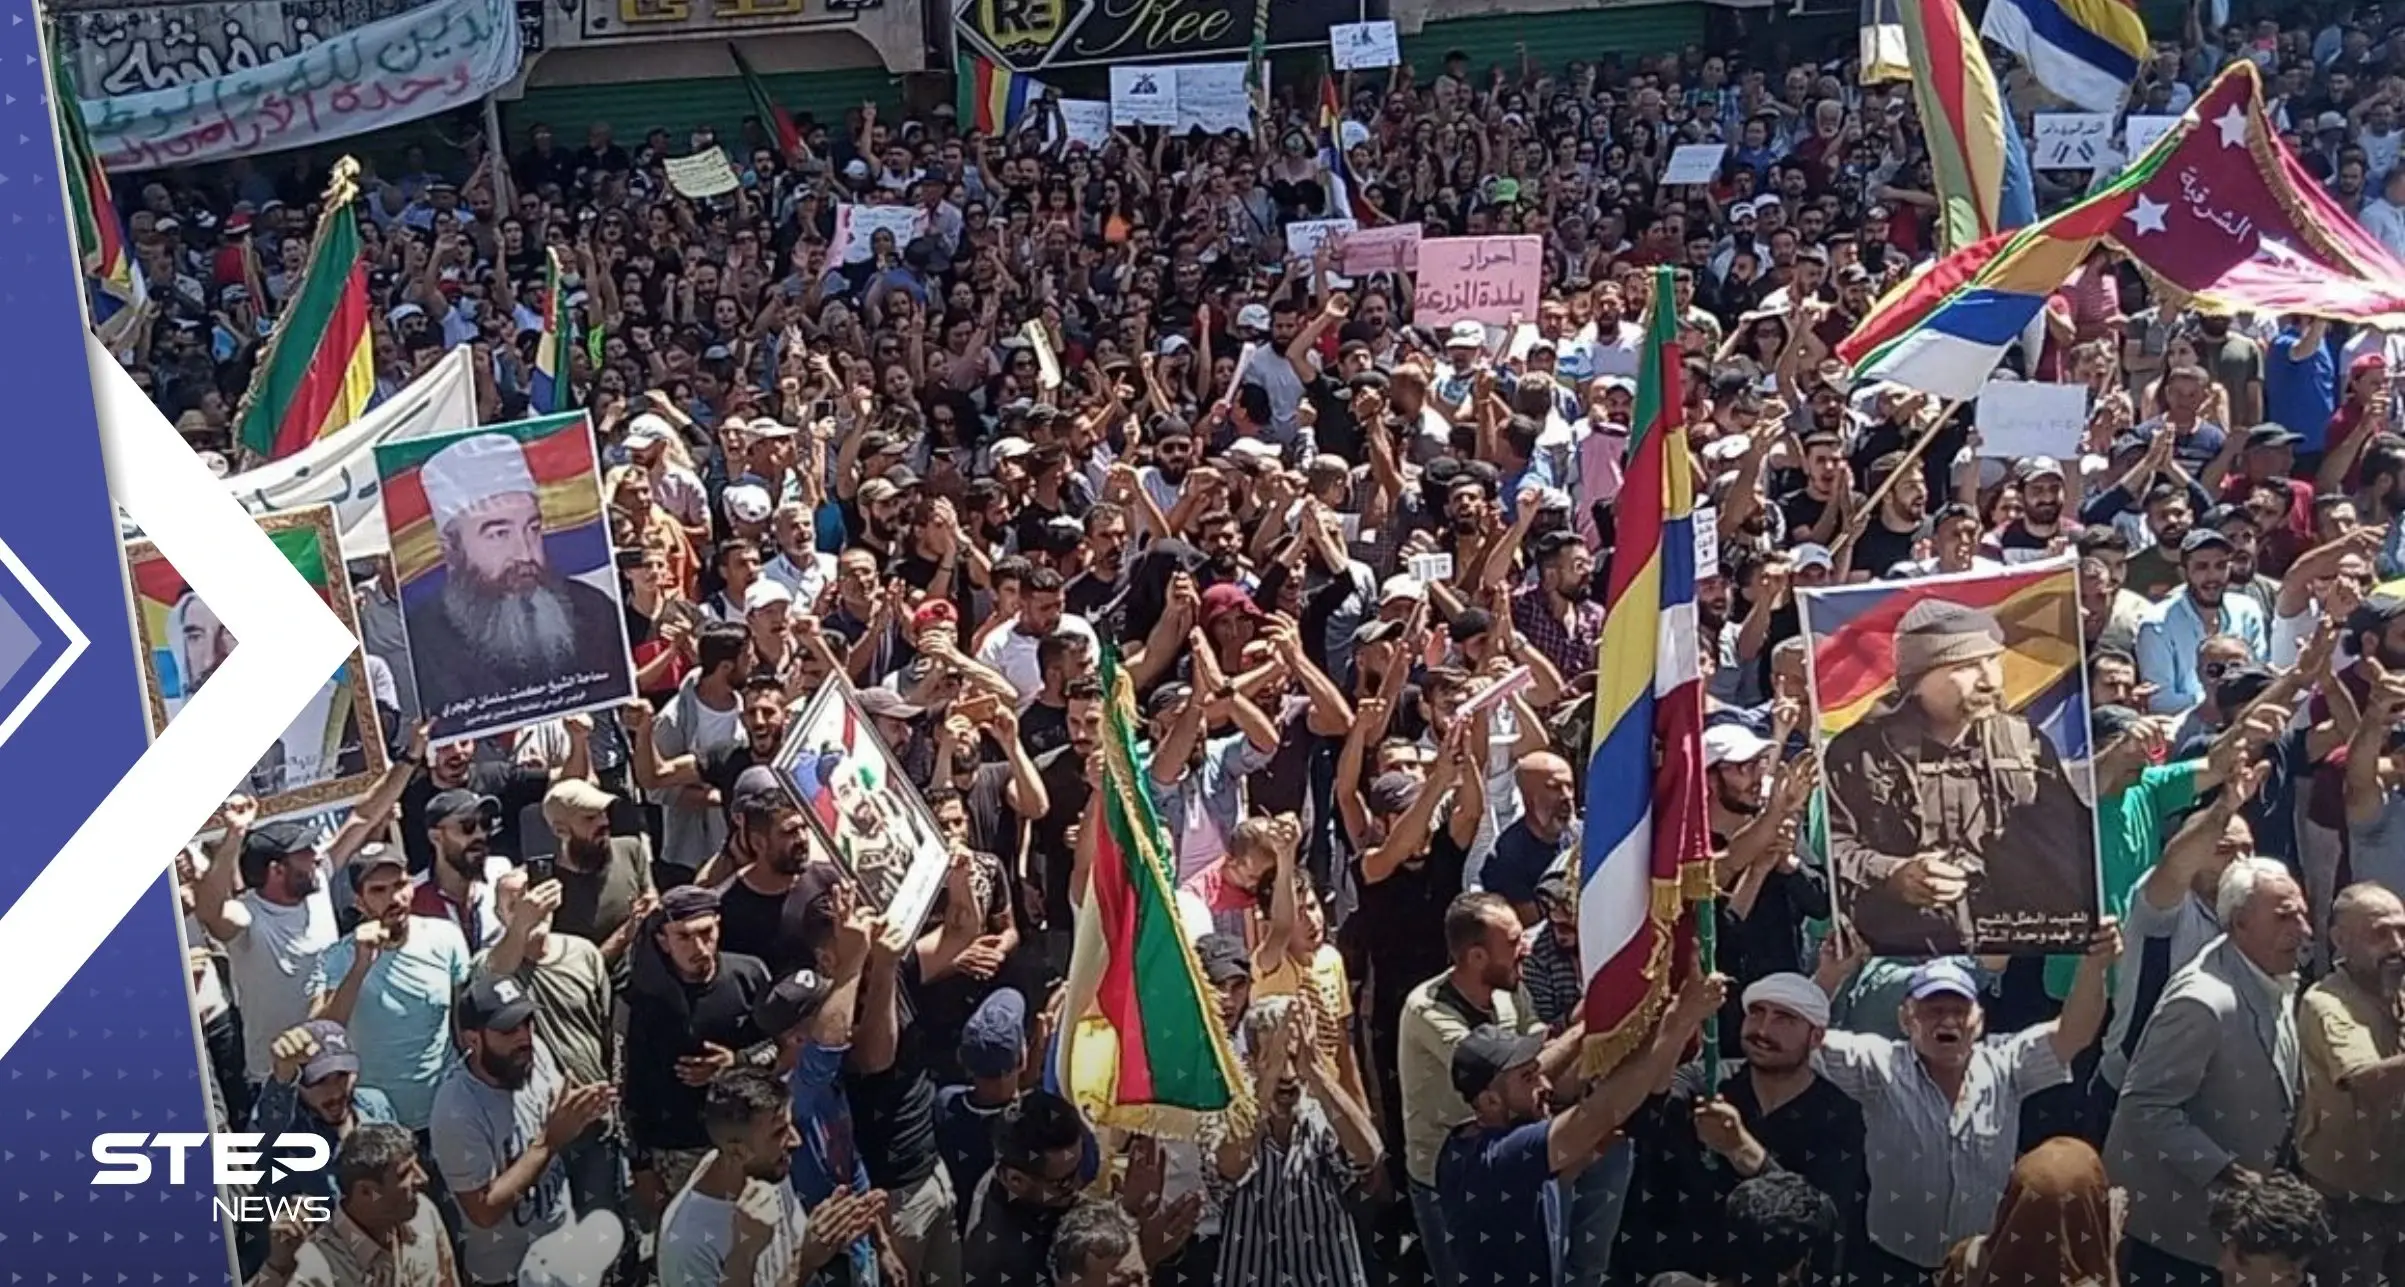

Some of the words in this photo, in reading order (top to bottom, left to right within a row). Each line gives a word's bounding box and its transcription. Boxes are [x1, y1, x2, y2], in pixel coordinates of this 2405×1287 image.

[331, 62, 470, 113] وحدة
[2179, 165, 2253, 244] الشرقية
[1415, 279, 1477, 315] المزرعة
[1478, 279, 1525, 313] بلدة
[1977, 911, 2012, 932] الشيخ
[2011, 911, 2046, 926] البطل
[2047, 911, 2089, 928] الشهيد
